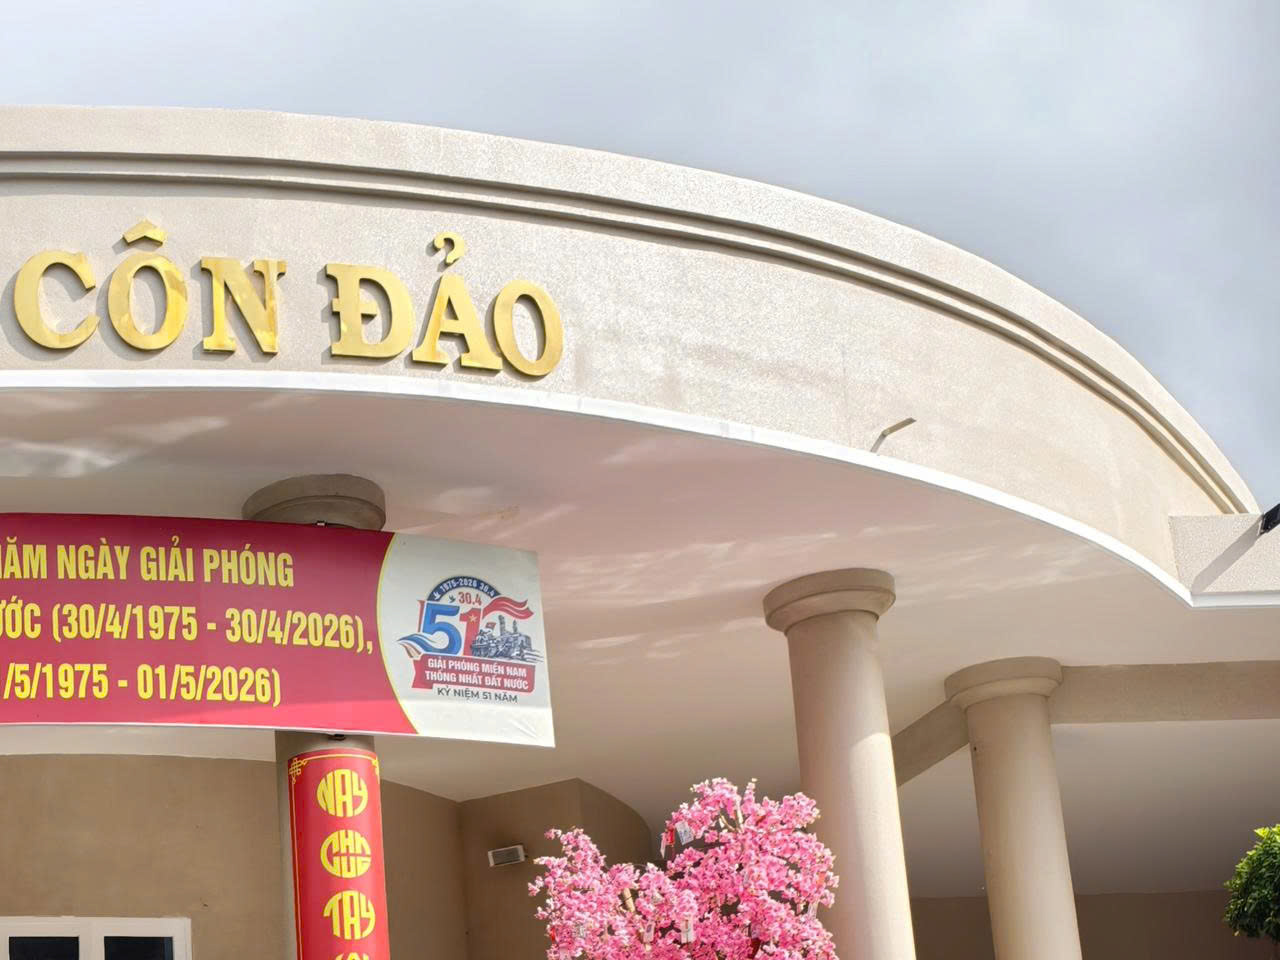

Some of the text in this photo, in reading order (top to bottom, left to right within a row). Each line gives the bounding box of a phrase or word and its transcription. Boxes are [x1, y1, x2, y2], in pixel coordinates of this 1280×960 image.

[14, 219, 287, 356] CÔN
[324, 231, 565, 377] ĐẢO
[57, 537, 131, 581] NGÀY
[139, 535, 195, 582] GIẢI
[203, 543, 295, 588] PHÓNG
[457, 591, 483, 606] 30.4
[52, 603, 198, 643] (30/4/1975
[206, 622, 217, 631] -
[225, 608, 374, 654] 30/4/2026),
[421, 602, 482, 657] 51
[117, 679, 128, 689] -
[136, 663, 281, 708] 01/5/2026)
[482, 691, 493, 701] 51
[317, 768, 369, 817] NAY
[323, 889, 377, 941] TAY
